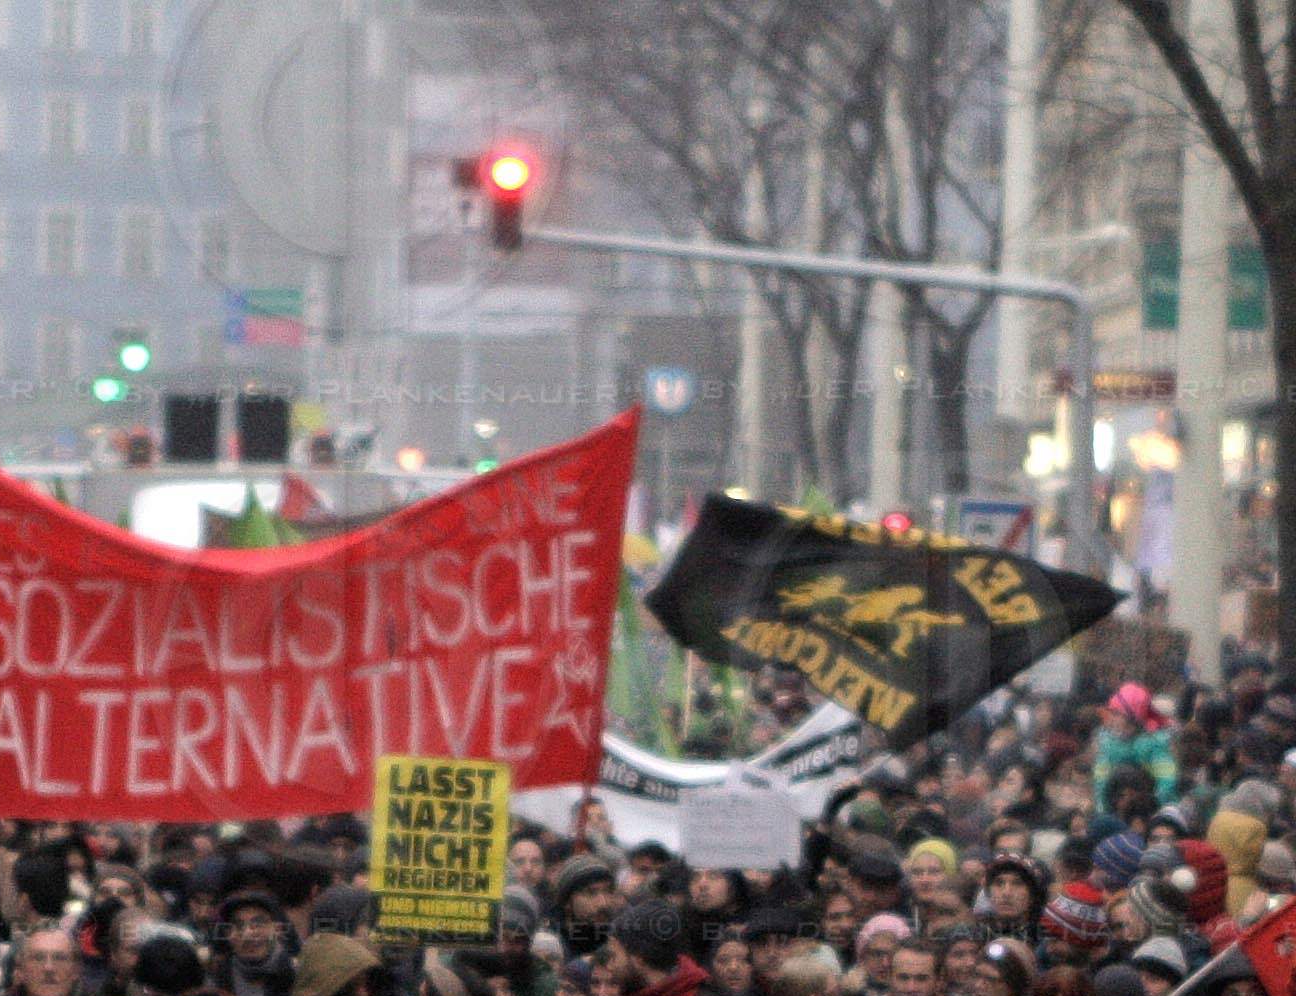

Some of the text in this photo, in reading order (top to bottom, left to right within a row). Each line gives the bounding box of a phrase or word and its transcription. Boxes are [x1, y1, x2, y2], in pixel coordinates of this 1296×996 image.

[390, 763, 496, 800] LASST
[388, 797, 494, 834] NAZIS
[386, 832, 493, 870] NICHT
[383, 867, 490, 893] REGIEREN
